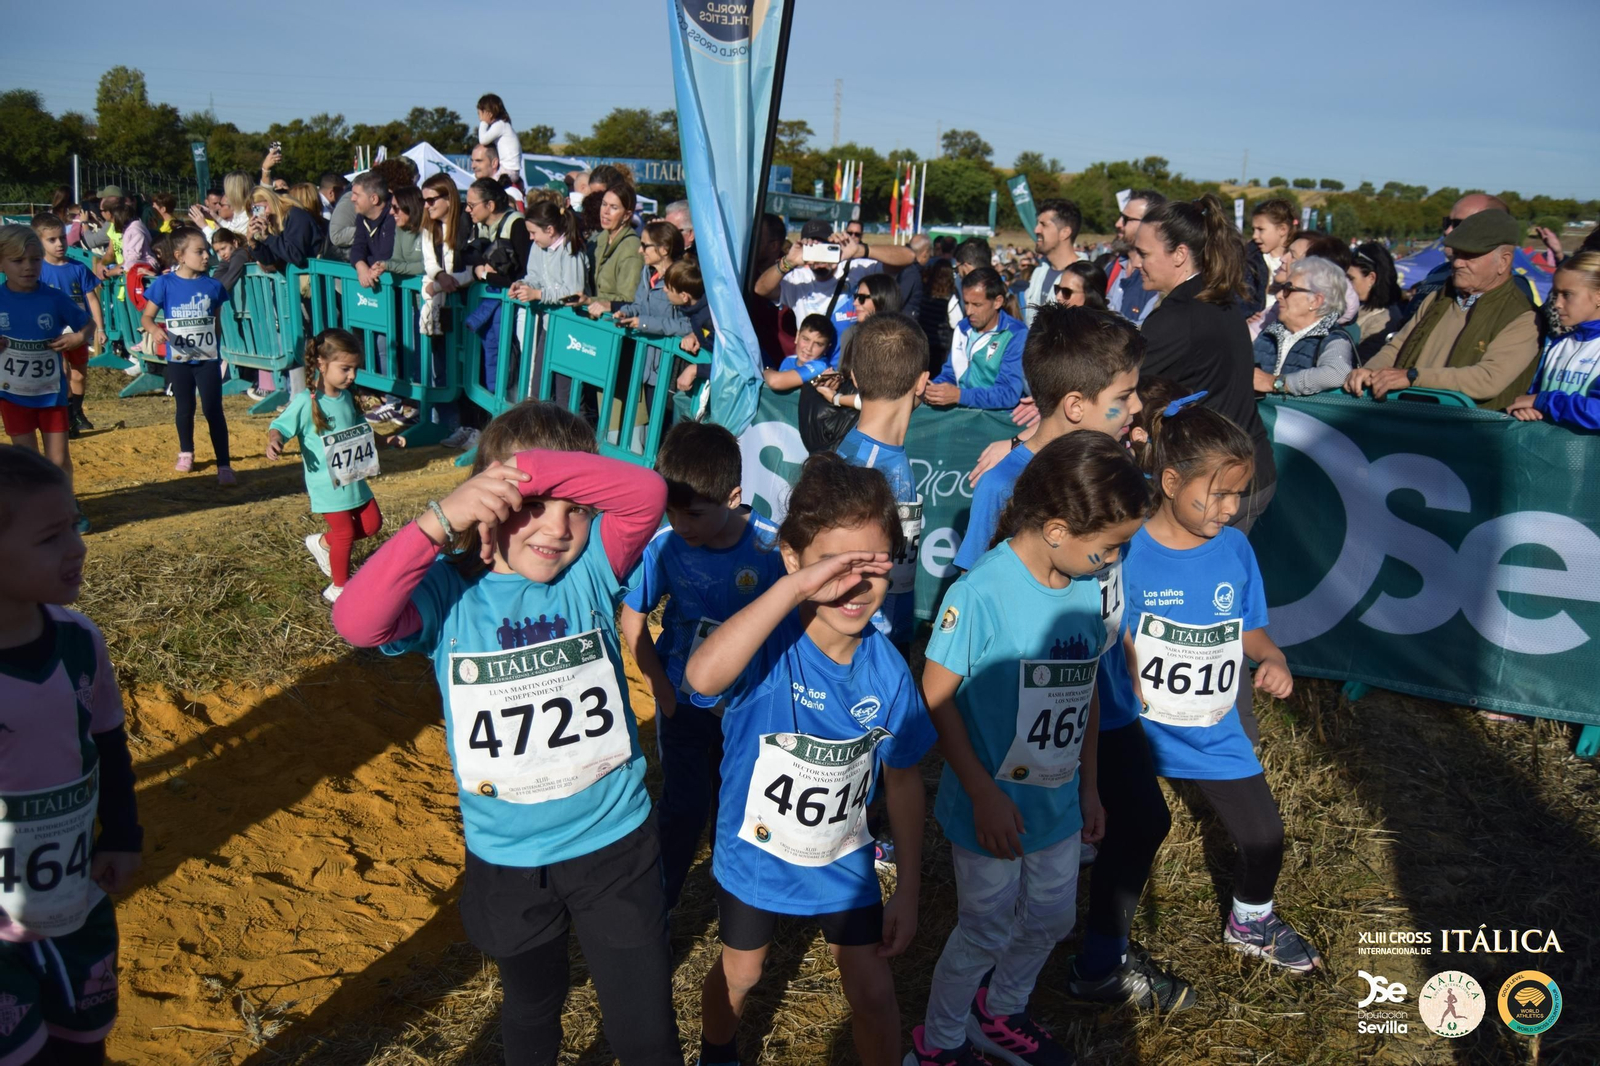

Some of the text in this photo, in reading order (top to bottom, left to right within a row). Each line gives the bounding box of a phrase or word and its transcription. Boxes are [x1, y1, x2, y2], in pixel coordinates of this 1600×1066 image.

[174, 331, 214, 349] 4670
[4, 358, 55, 378] 4739
[331, 442, 374, 469] 4744
[1143, 588, 1184, 598] Los niños
[1144, 597, 1184, 606] del barrio
[1171, 629, 1219, 644] ITÁLICA
[487, 648, 570, 678] ITÁLICA
[510, 681, 540, 693] MARTIN
[541, 674, 576, 687] GONELLA
[1141, 656, 1236, 696] 4610
[504, 684, 564, 702] INDEPENDIENTE
[469, 686, 614, 758] 4723
[793, 762, 820, 775] HECTOR
[798, 772, 811, 780] LOS
[22, 785, 90, 816] ITÁLICA
[764, 769, 870, 827] 4614
